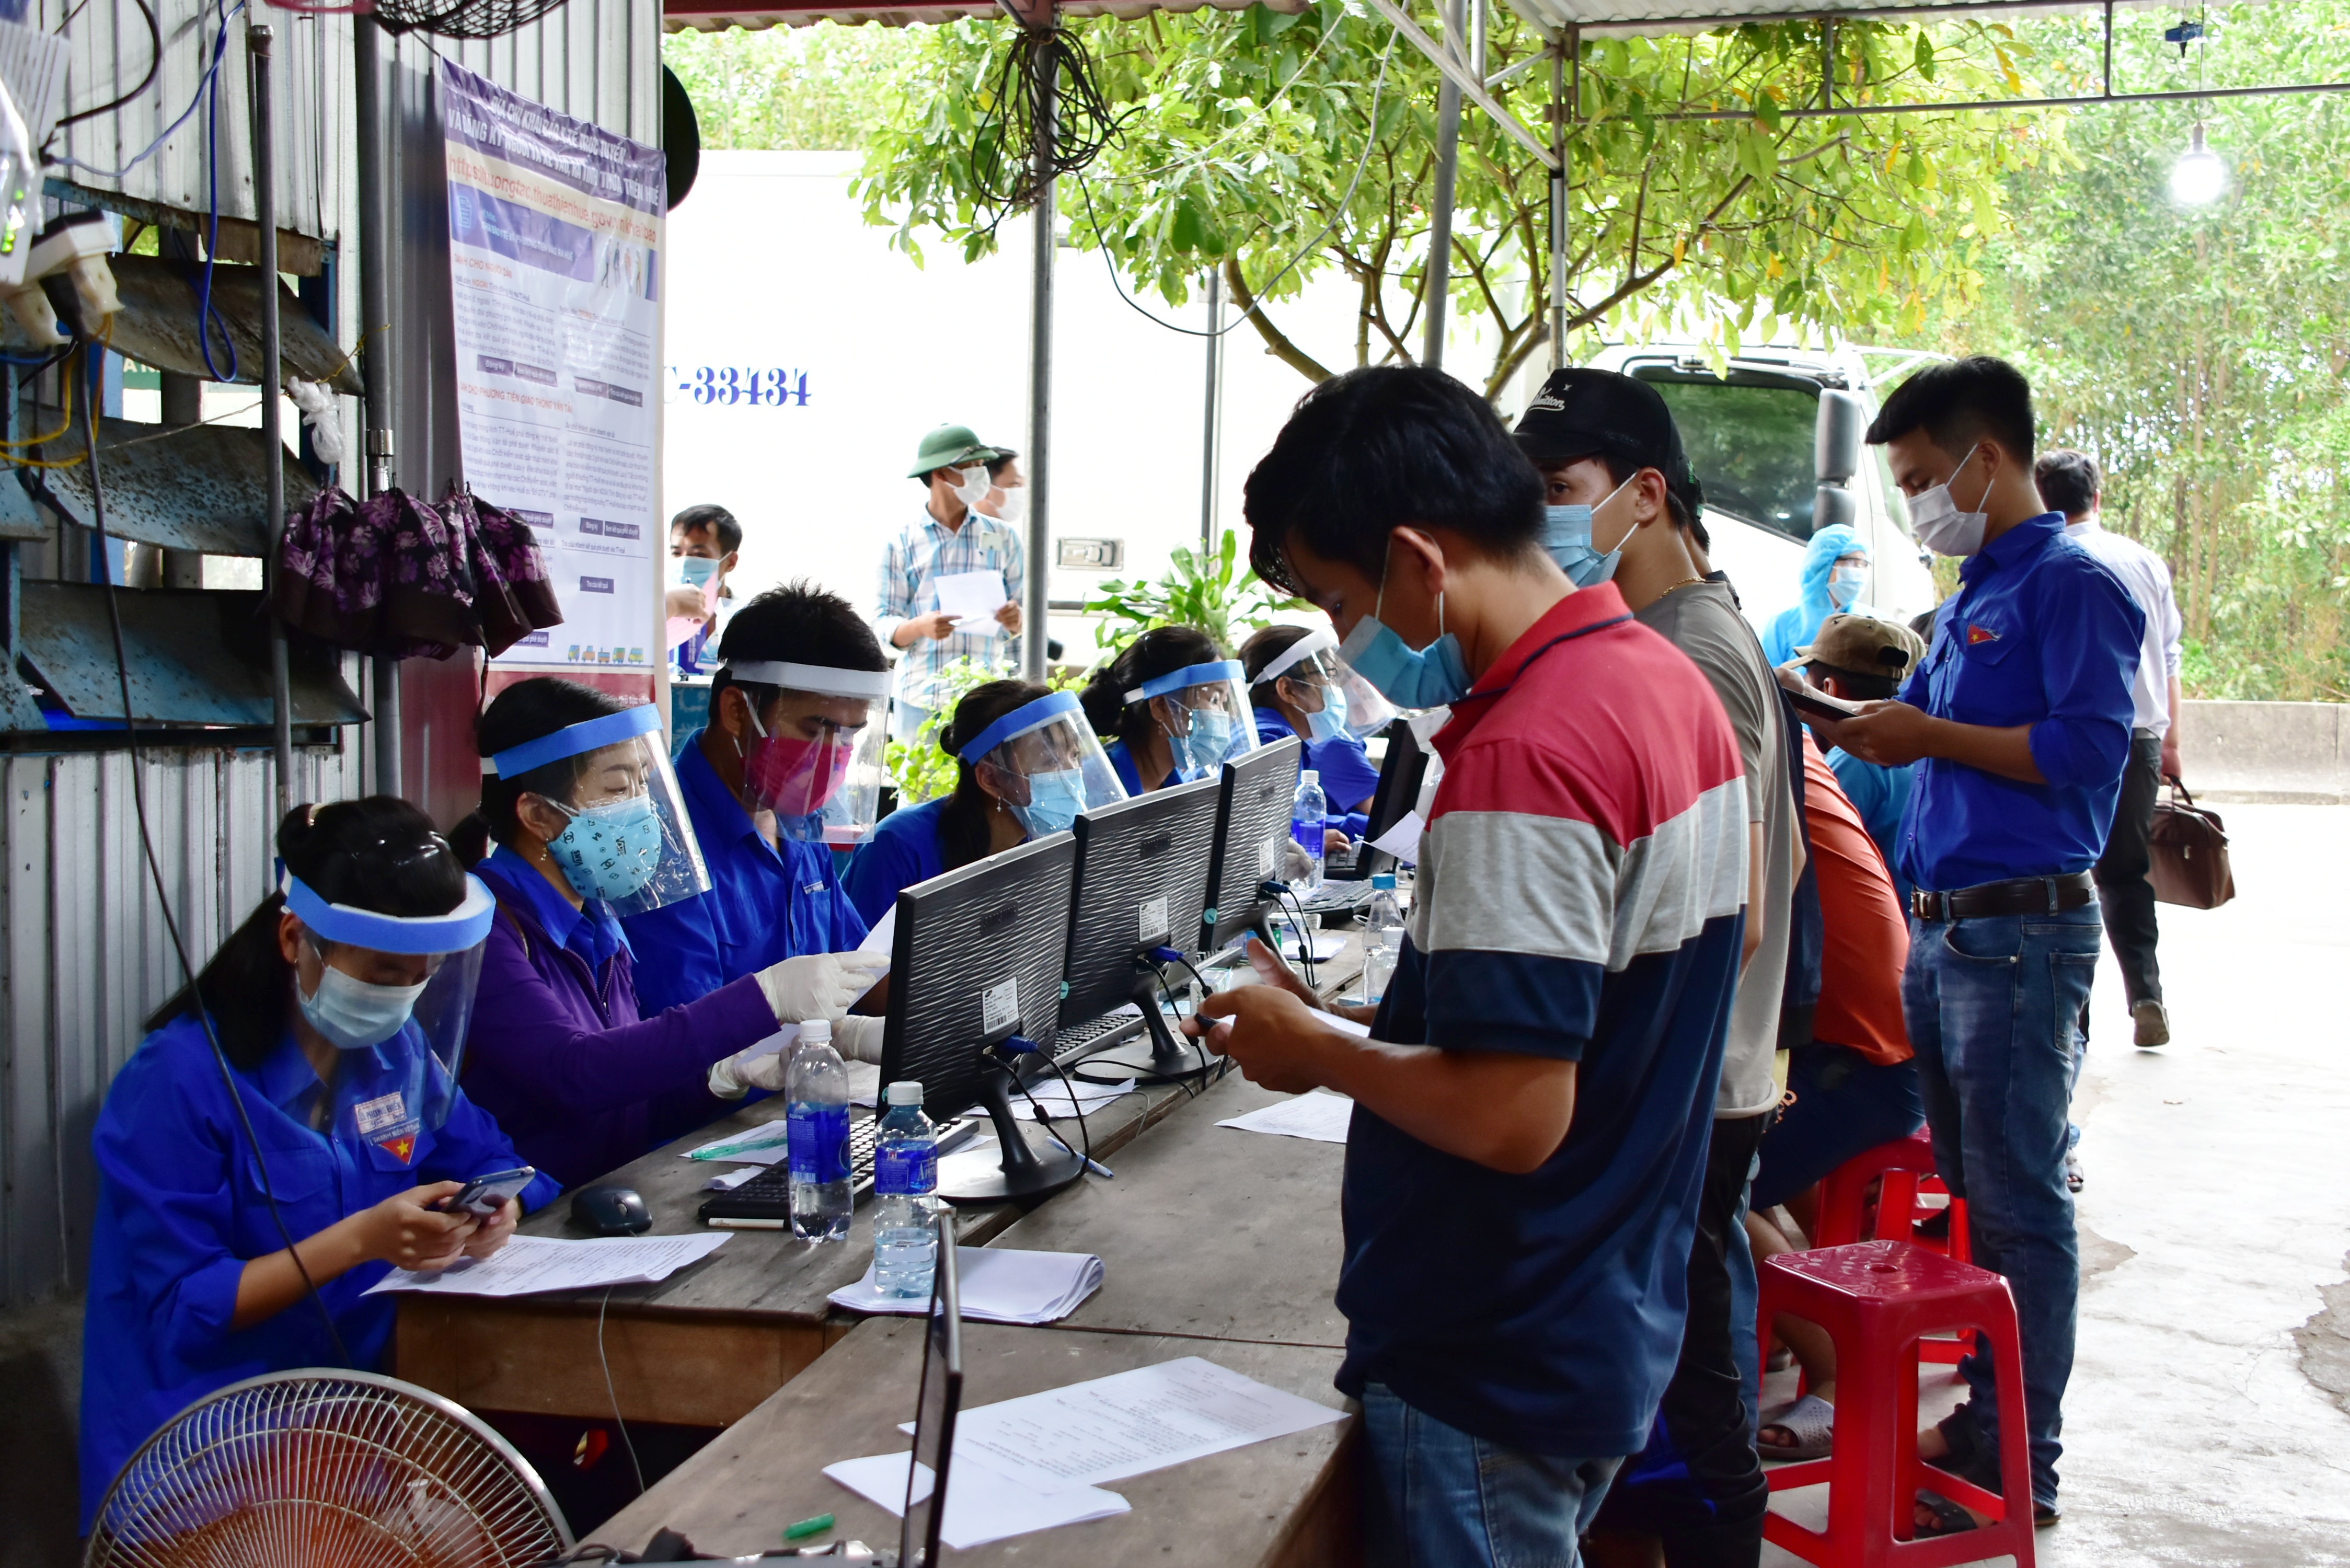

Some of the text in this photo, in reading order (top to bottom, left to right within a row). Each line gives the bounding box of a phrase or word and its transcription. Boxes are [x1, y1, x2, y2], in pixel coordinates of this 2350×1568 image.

[522, 108, 542, 135] KHAI
[447, 102, 462, 132] VÀ
[644, 179, 660, 207] HUẾ
[468, 257, 483, 271] CHO
[478, 385, 505, 401] PHƯƠNG
[520, 394, 534, 406] GIAO
[571, 849, 583, 867] VANS
